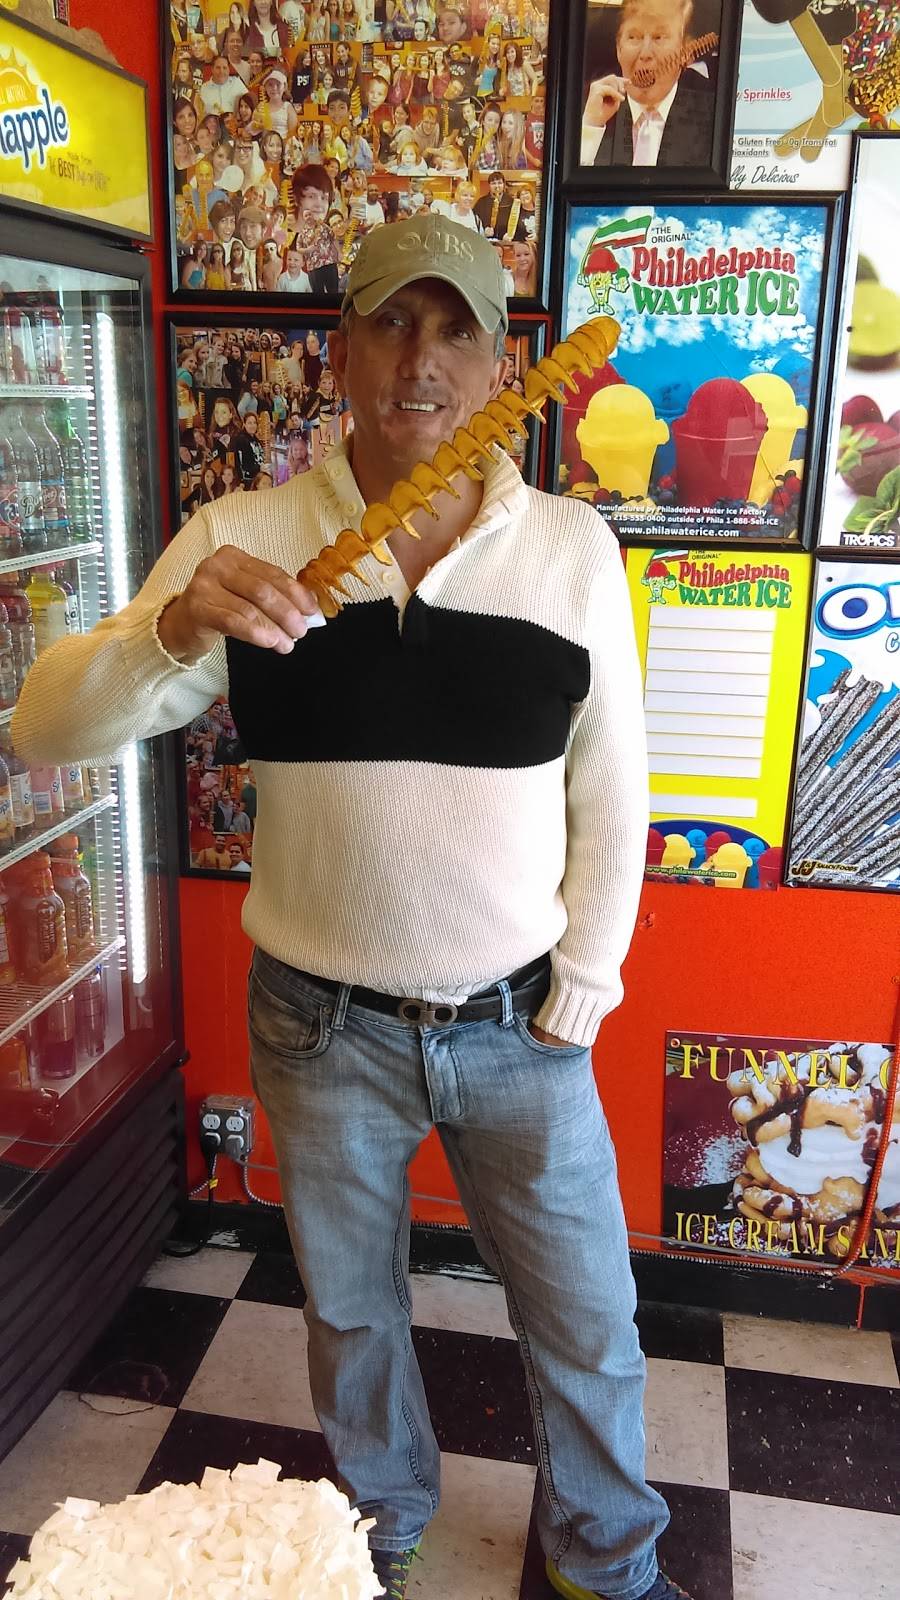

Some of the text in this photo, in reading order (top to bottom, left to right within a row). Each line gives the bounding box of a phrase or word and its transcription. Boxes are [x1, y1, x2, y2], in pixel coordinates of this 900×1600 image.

[744, 88, 791, 102] Sprinkles
[738, 138, 763, 146] Gluten
[765, 138, 780, 146] Free
[751, 165, 799, 184] Delicious
[651, 226, 672, 234] "THE
[651, 232, 694, 244] ORIGINAL"
[424, 231, 474, 262] CBS
[631, 246, 796, 287] Philadelphia
[631, 271, 799, 316] WATER ICE
[596, 504, 645, 512] Manufactured
[648, 505, 657, 514] by
[658, 505, 701, 514] Philadelphia
[739, 508, 767, 517] Factory
[706, 516, 724, 524] Phila
[619, 526, 740, 537] www.philawaterice.com
[843, 533, 895, 547] TROPICS
[679, 561, 790, 588] Philadelphia
[679, 579, 792, 608] WATER ICE
[645, 867, 737, 878] www.philawaterice.com
[680, 1043, 860, 1091] FUNNEL
[674, 1211, 718, 1246] ICE
[728, 1217, 826, 1256] CREAM
